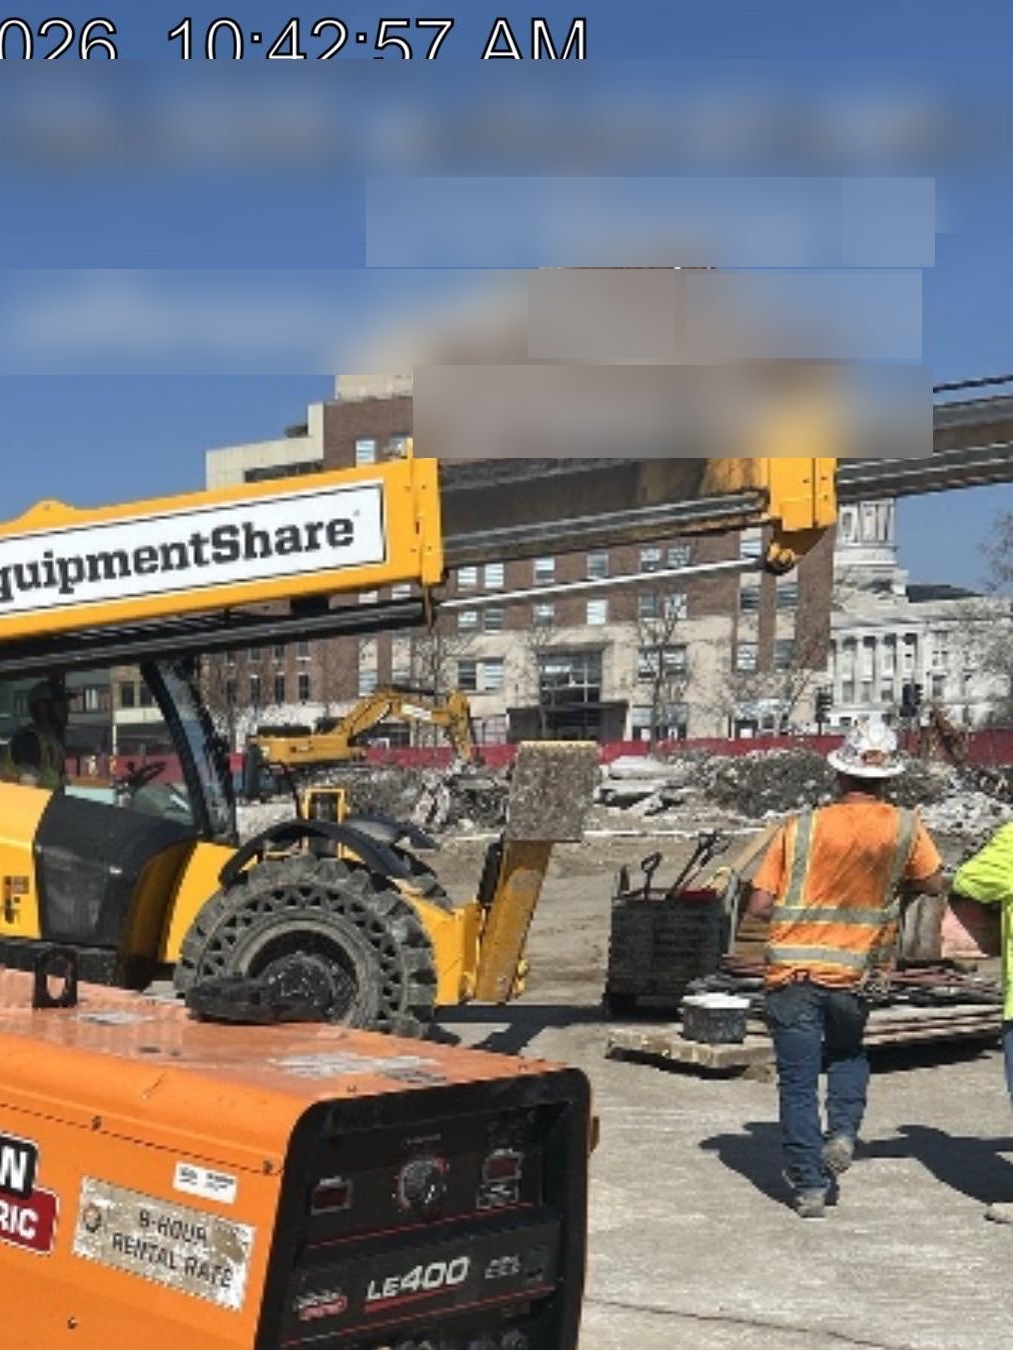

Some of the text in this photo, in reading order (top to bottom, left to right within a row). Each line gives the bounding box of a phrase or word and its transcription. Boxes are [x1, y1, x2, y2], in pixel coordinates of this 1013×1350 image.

[112, 1231, 234, 1289] RENTAL RATE
[367, 1256, 470, 1301] LE400
